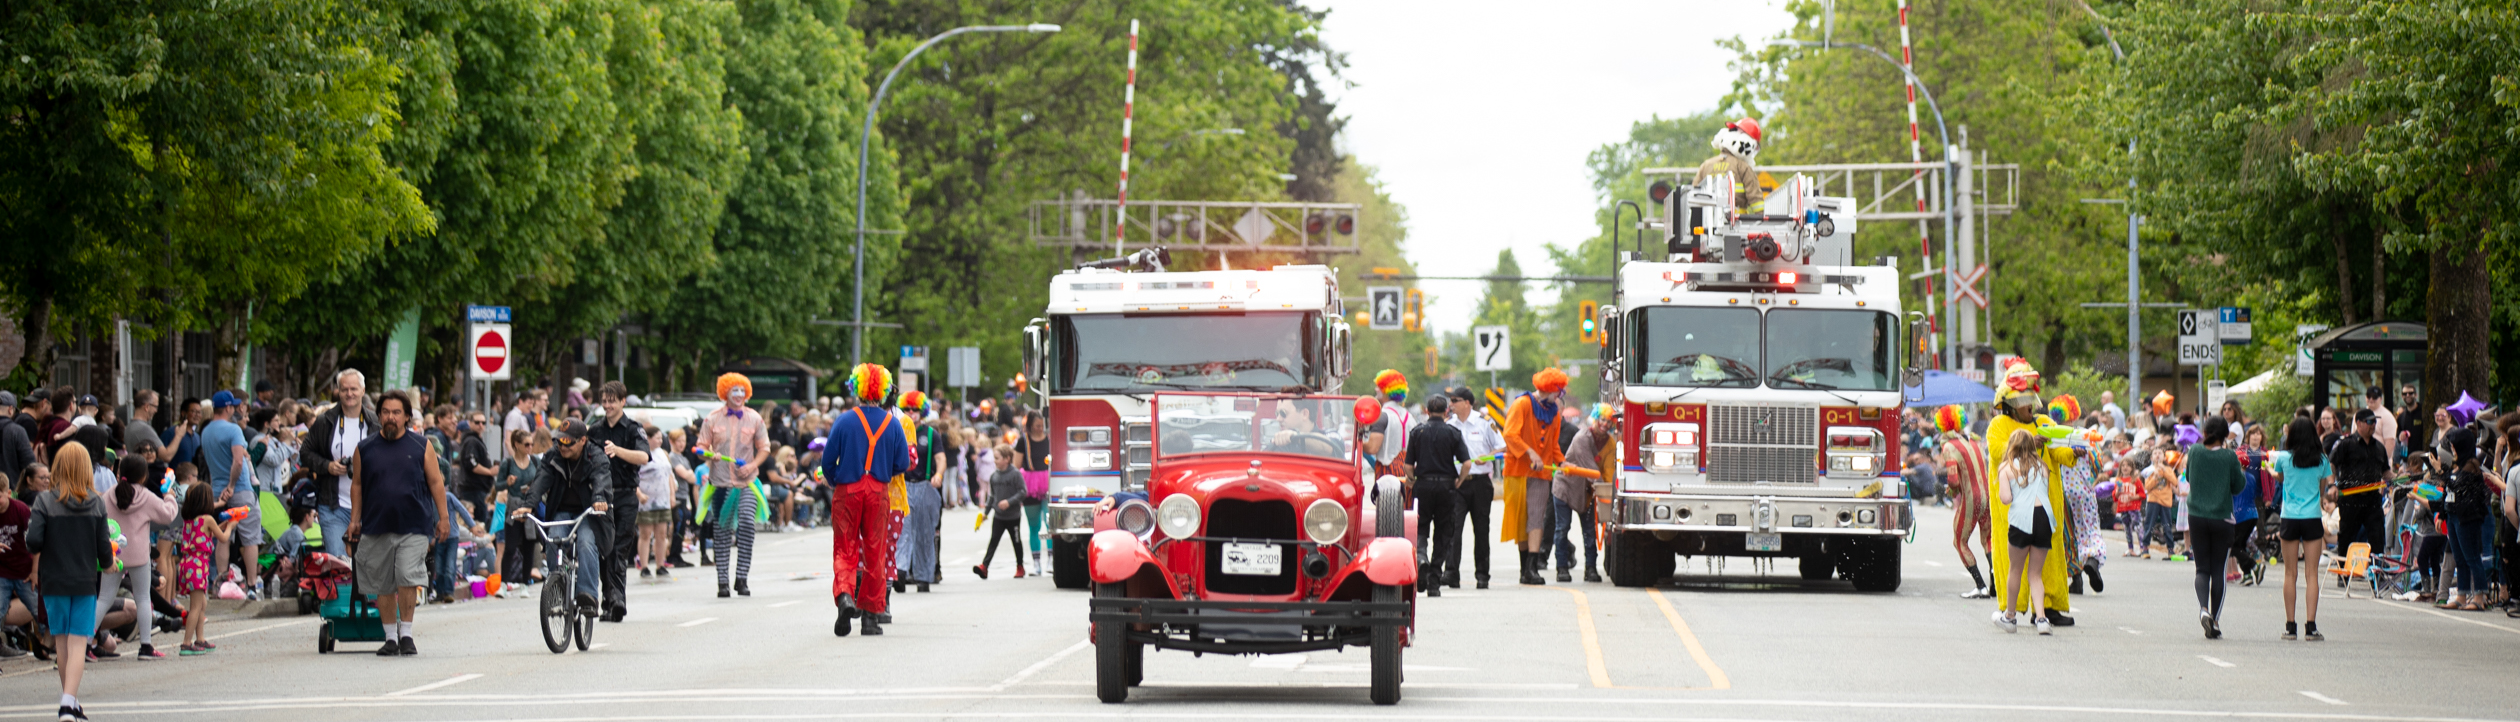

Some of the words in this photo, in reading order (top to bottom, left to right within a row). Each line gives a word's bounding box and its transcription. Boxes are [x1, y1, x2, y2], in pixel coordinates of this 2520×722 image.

[1713, 161, 1730, 171] PITT
[469, 307, 497, 320] DAVISON
[2349, 353, 2382, 361] DAVISON
[1673, 406, 1701, 420] Q-1
[1826, 410, 1853, 424] Q-1
[1257, 554, 1279, 564] 2209
